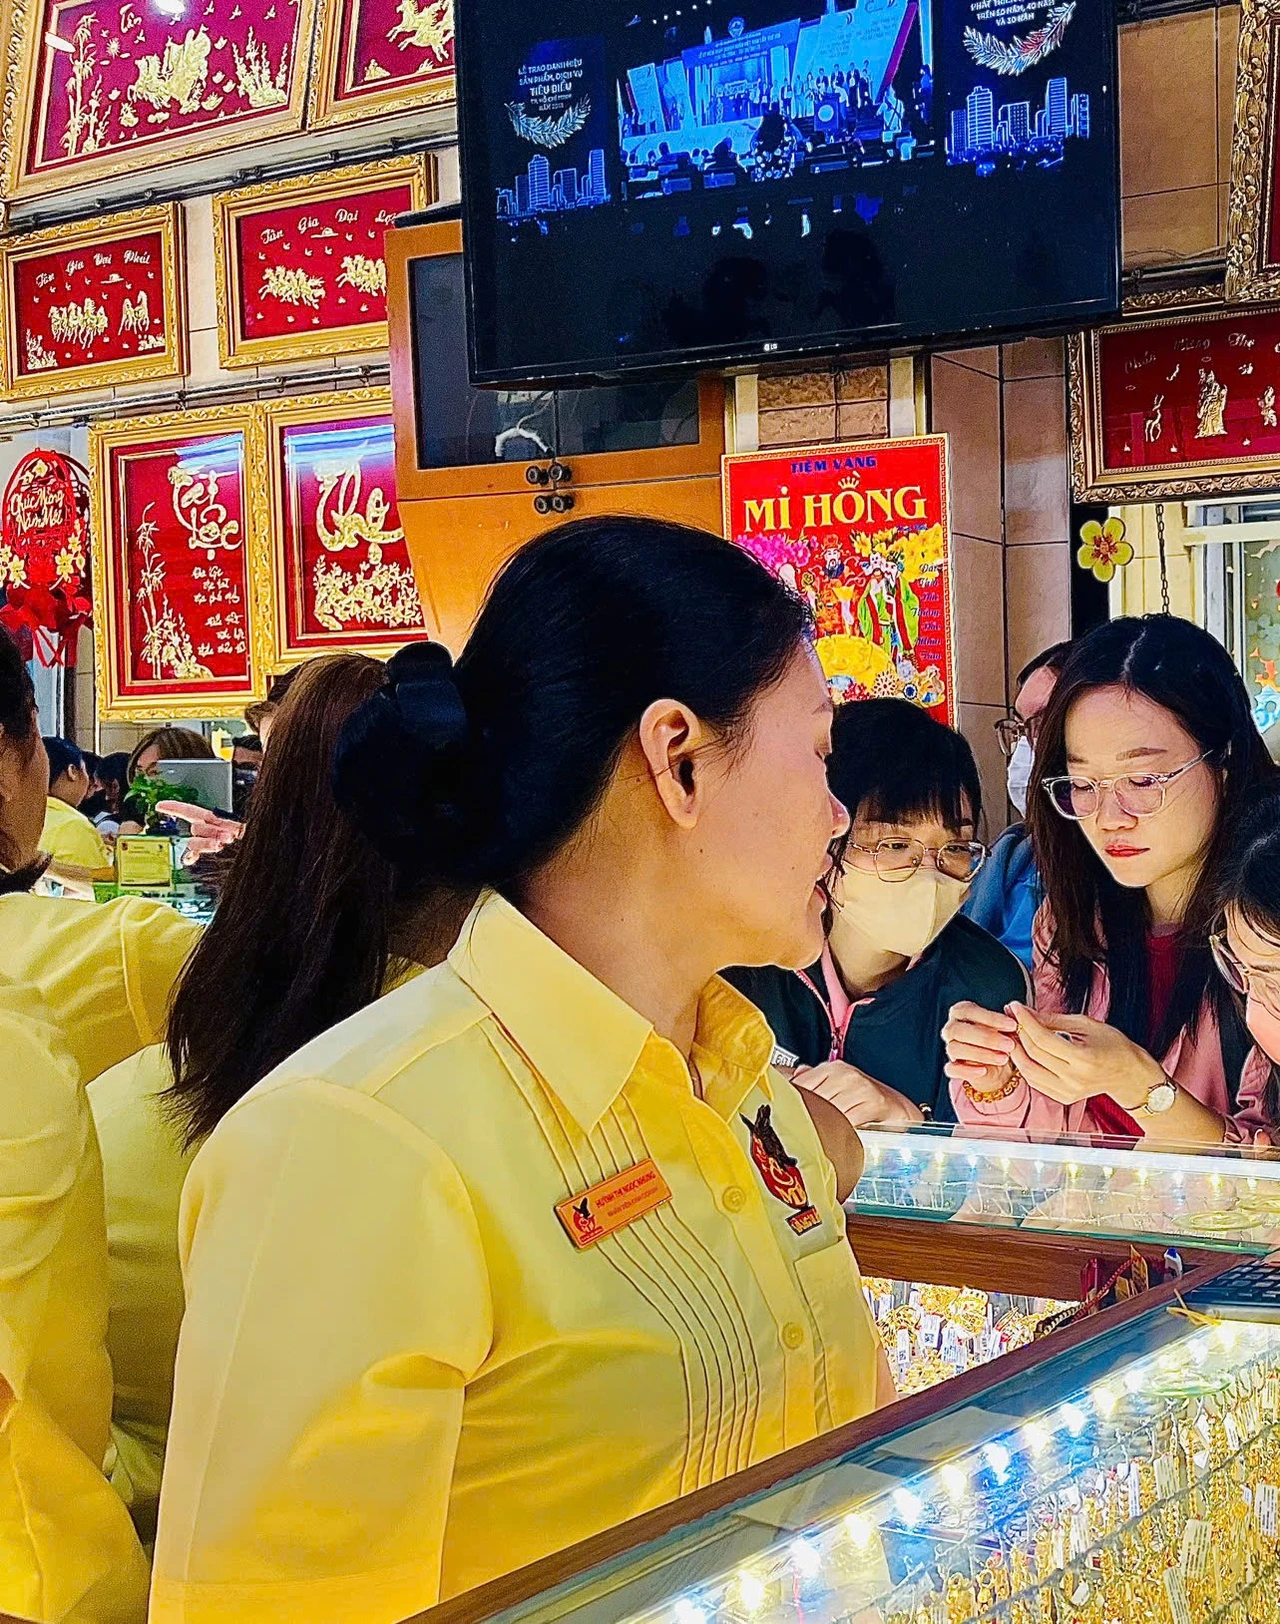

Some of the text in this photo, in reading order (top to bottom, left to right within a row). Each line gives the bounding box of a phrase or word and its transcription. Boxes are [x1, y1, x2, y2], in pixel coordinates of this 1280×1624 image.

[528, 64, 546, 75] TRAO
[529, 78, 572, 97] TIÊU BIỂU
